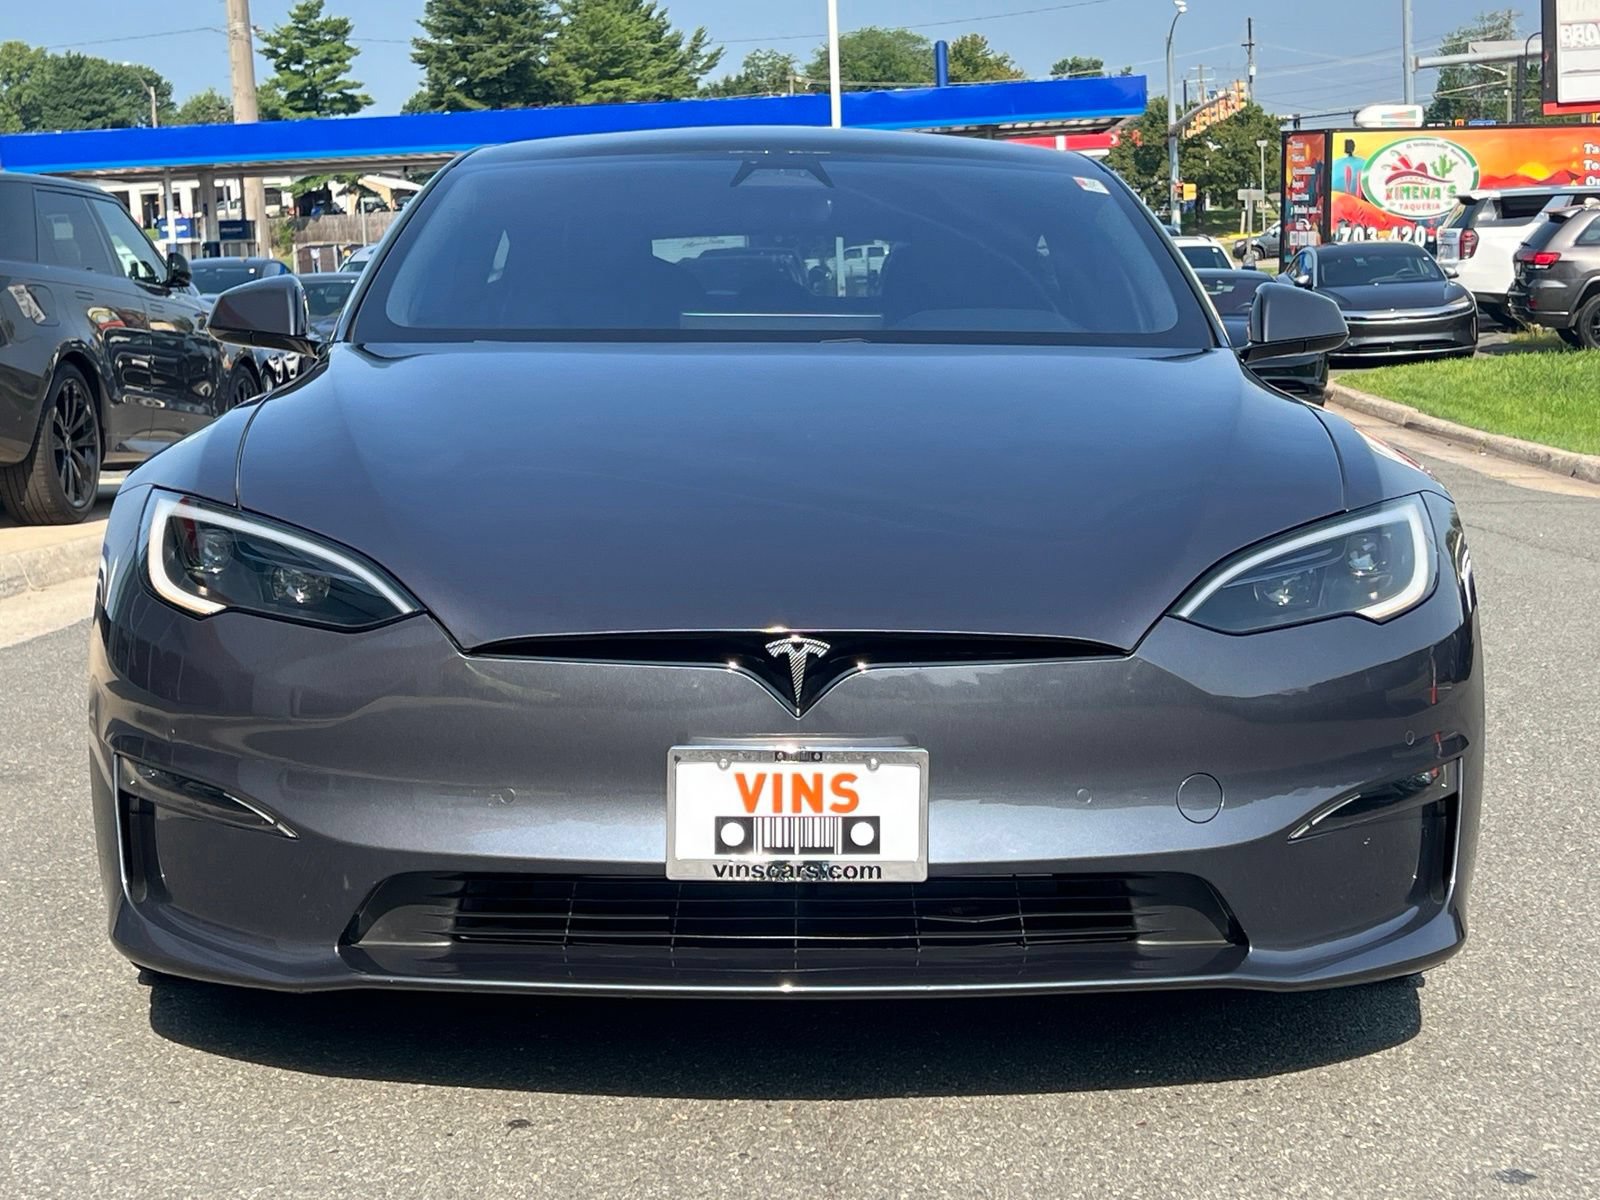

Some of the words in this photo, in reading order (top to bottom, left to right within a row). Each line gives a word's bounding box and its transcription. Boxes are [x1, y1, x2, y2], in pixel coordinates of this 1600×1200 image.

[1385, 184, 1457, 200] XIMENA'S
[1399, 202, 1440, 212] TAQUERIA
[734, 773, 859, 814] VINS
[712, 861, 883, 881] vinscars.com
